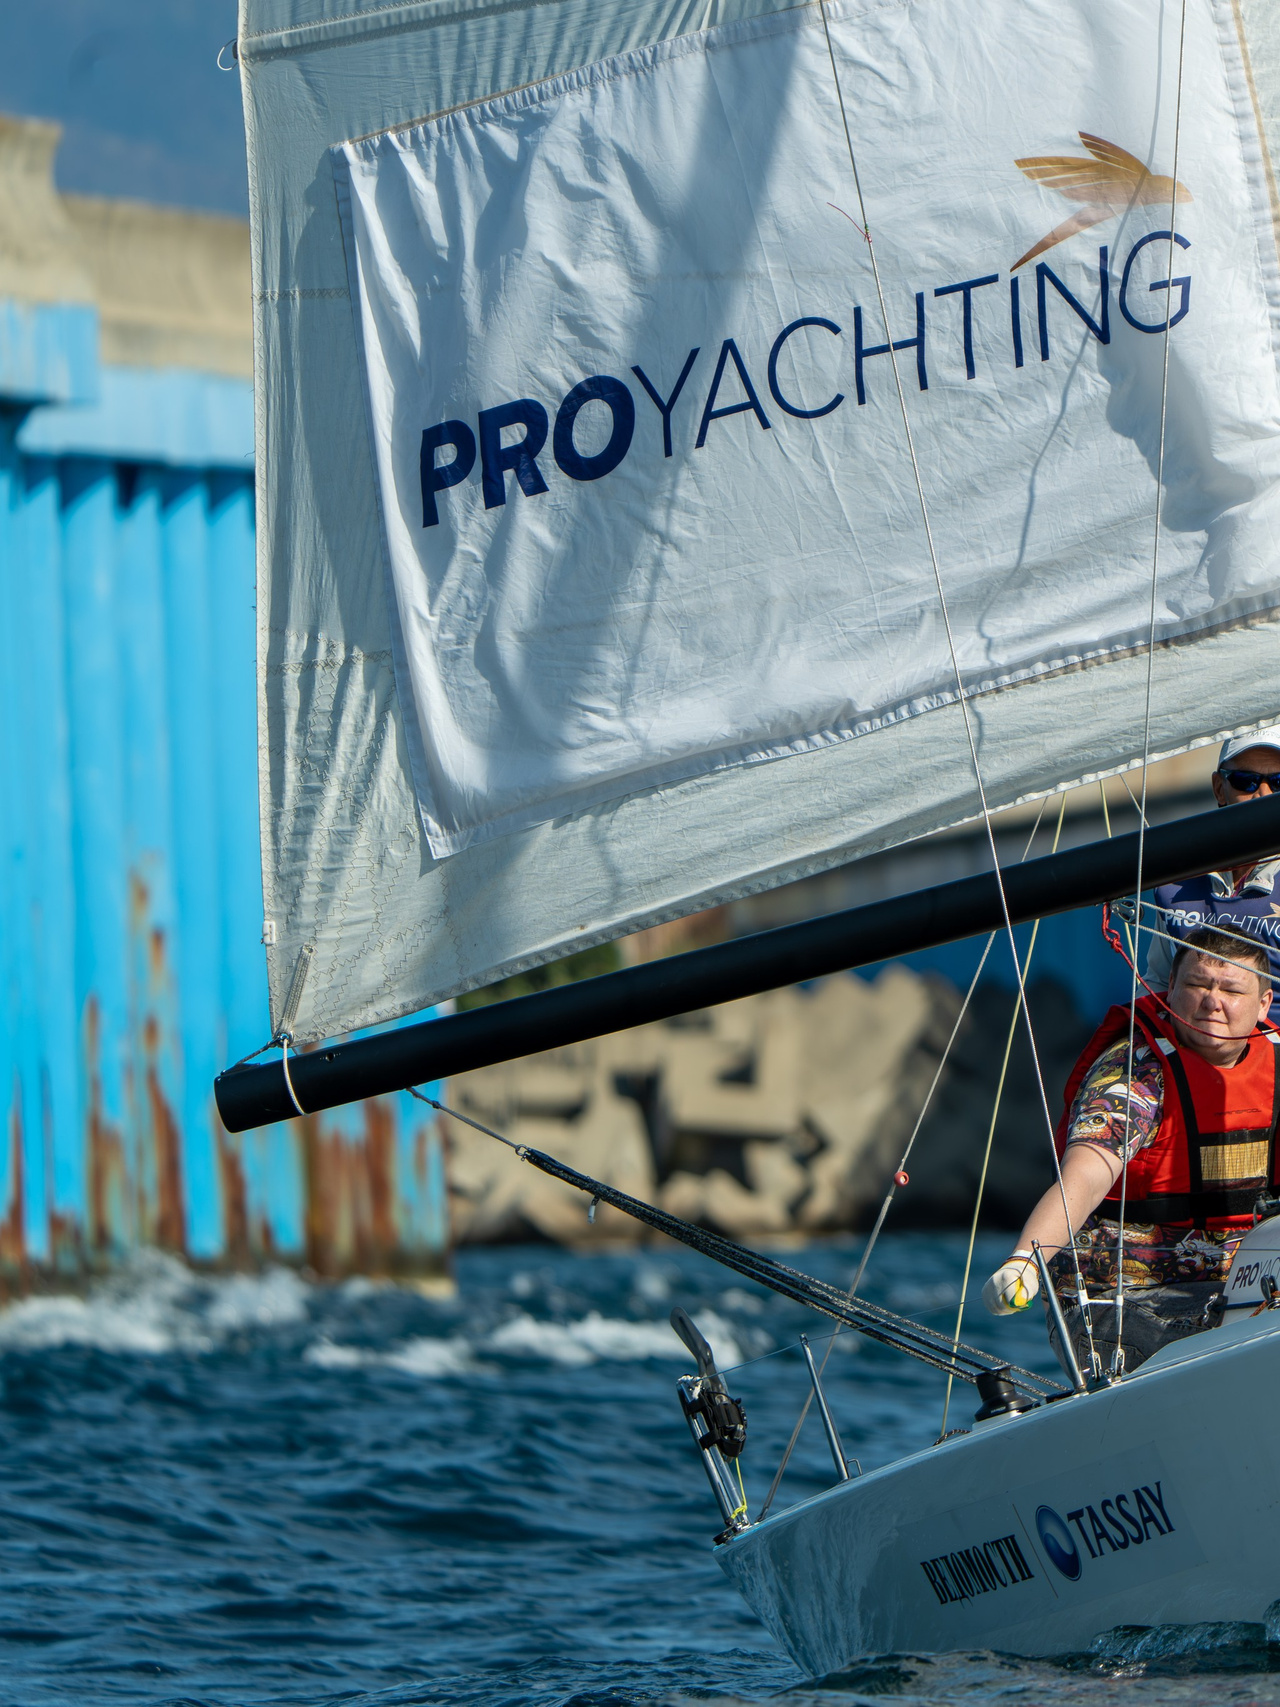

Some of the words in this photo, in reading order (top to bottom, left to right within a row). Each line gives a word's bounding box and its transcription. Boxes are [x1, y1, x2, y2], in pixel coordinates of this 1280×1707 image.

[421, 230, 1193, 529] PROYACHTING
[1066, 1480, 1176, 1559] TASSAY
[919, 1533, 1035, 1609] ВЕДОМОСТИ
